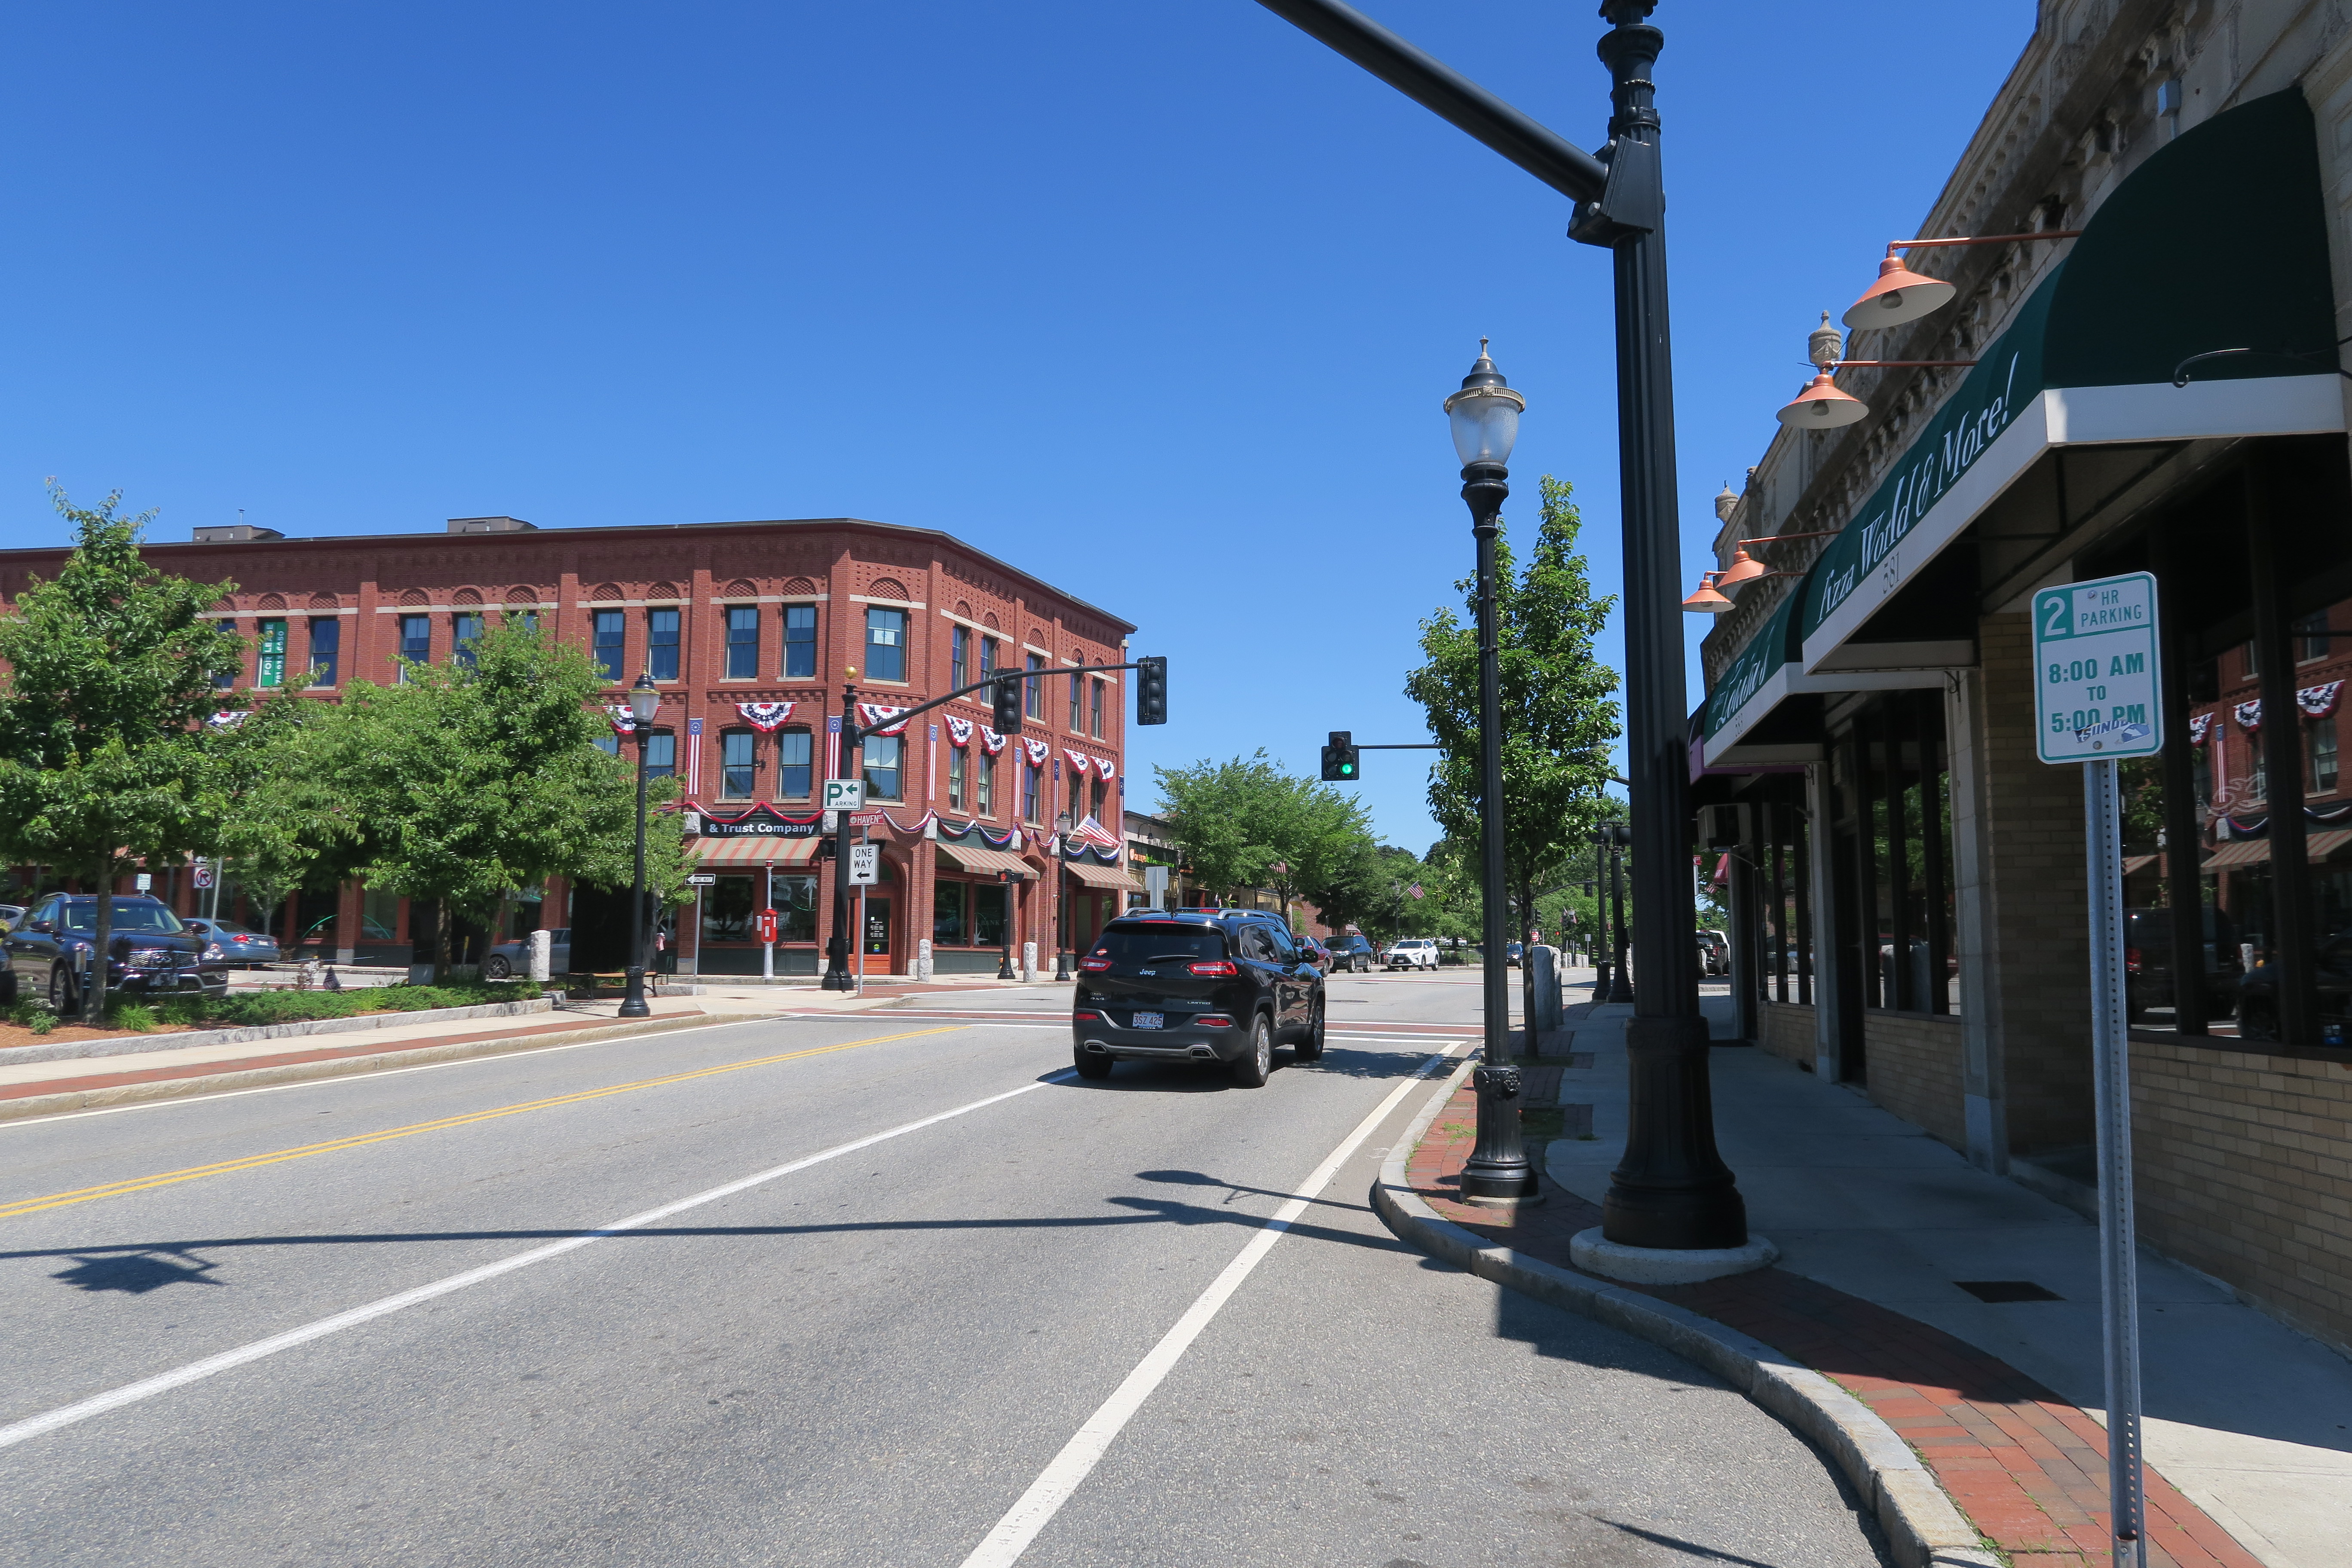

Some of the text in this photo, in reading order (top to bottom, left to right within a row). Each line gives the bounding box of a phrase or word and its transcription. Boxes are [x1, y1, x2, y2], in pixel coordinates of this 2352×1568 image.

[1861, 462, 1919, 576] World
[1916, 453, 1934, 517] &
[1934, 351, 2019, 498] More!
[1883, 551, 1899, 594] 581
[2101, 589, 2119, 606] HR
[2043, 596, 2066, 637] 2
[2081, 604, 2142, 628] PARKING
[264, 656, 273, 675] FOR
[2049, 652, 2144, 684] 8:00 AM
[2087, 685, 2106, 701] TO
[2051, 704, 2145, 733] 5:00 PM
[709, 823, 815, 834] & Trust Company
[857, 815, 879, 824] HAVEN
[855, 848, 873, 858] ONE
[854, 859, 873, 868] WAY
[1134, 1016, 1162, 1026] 3SZ 425
